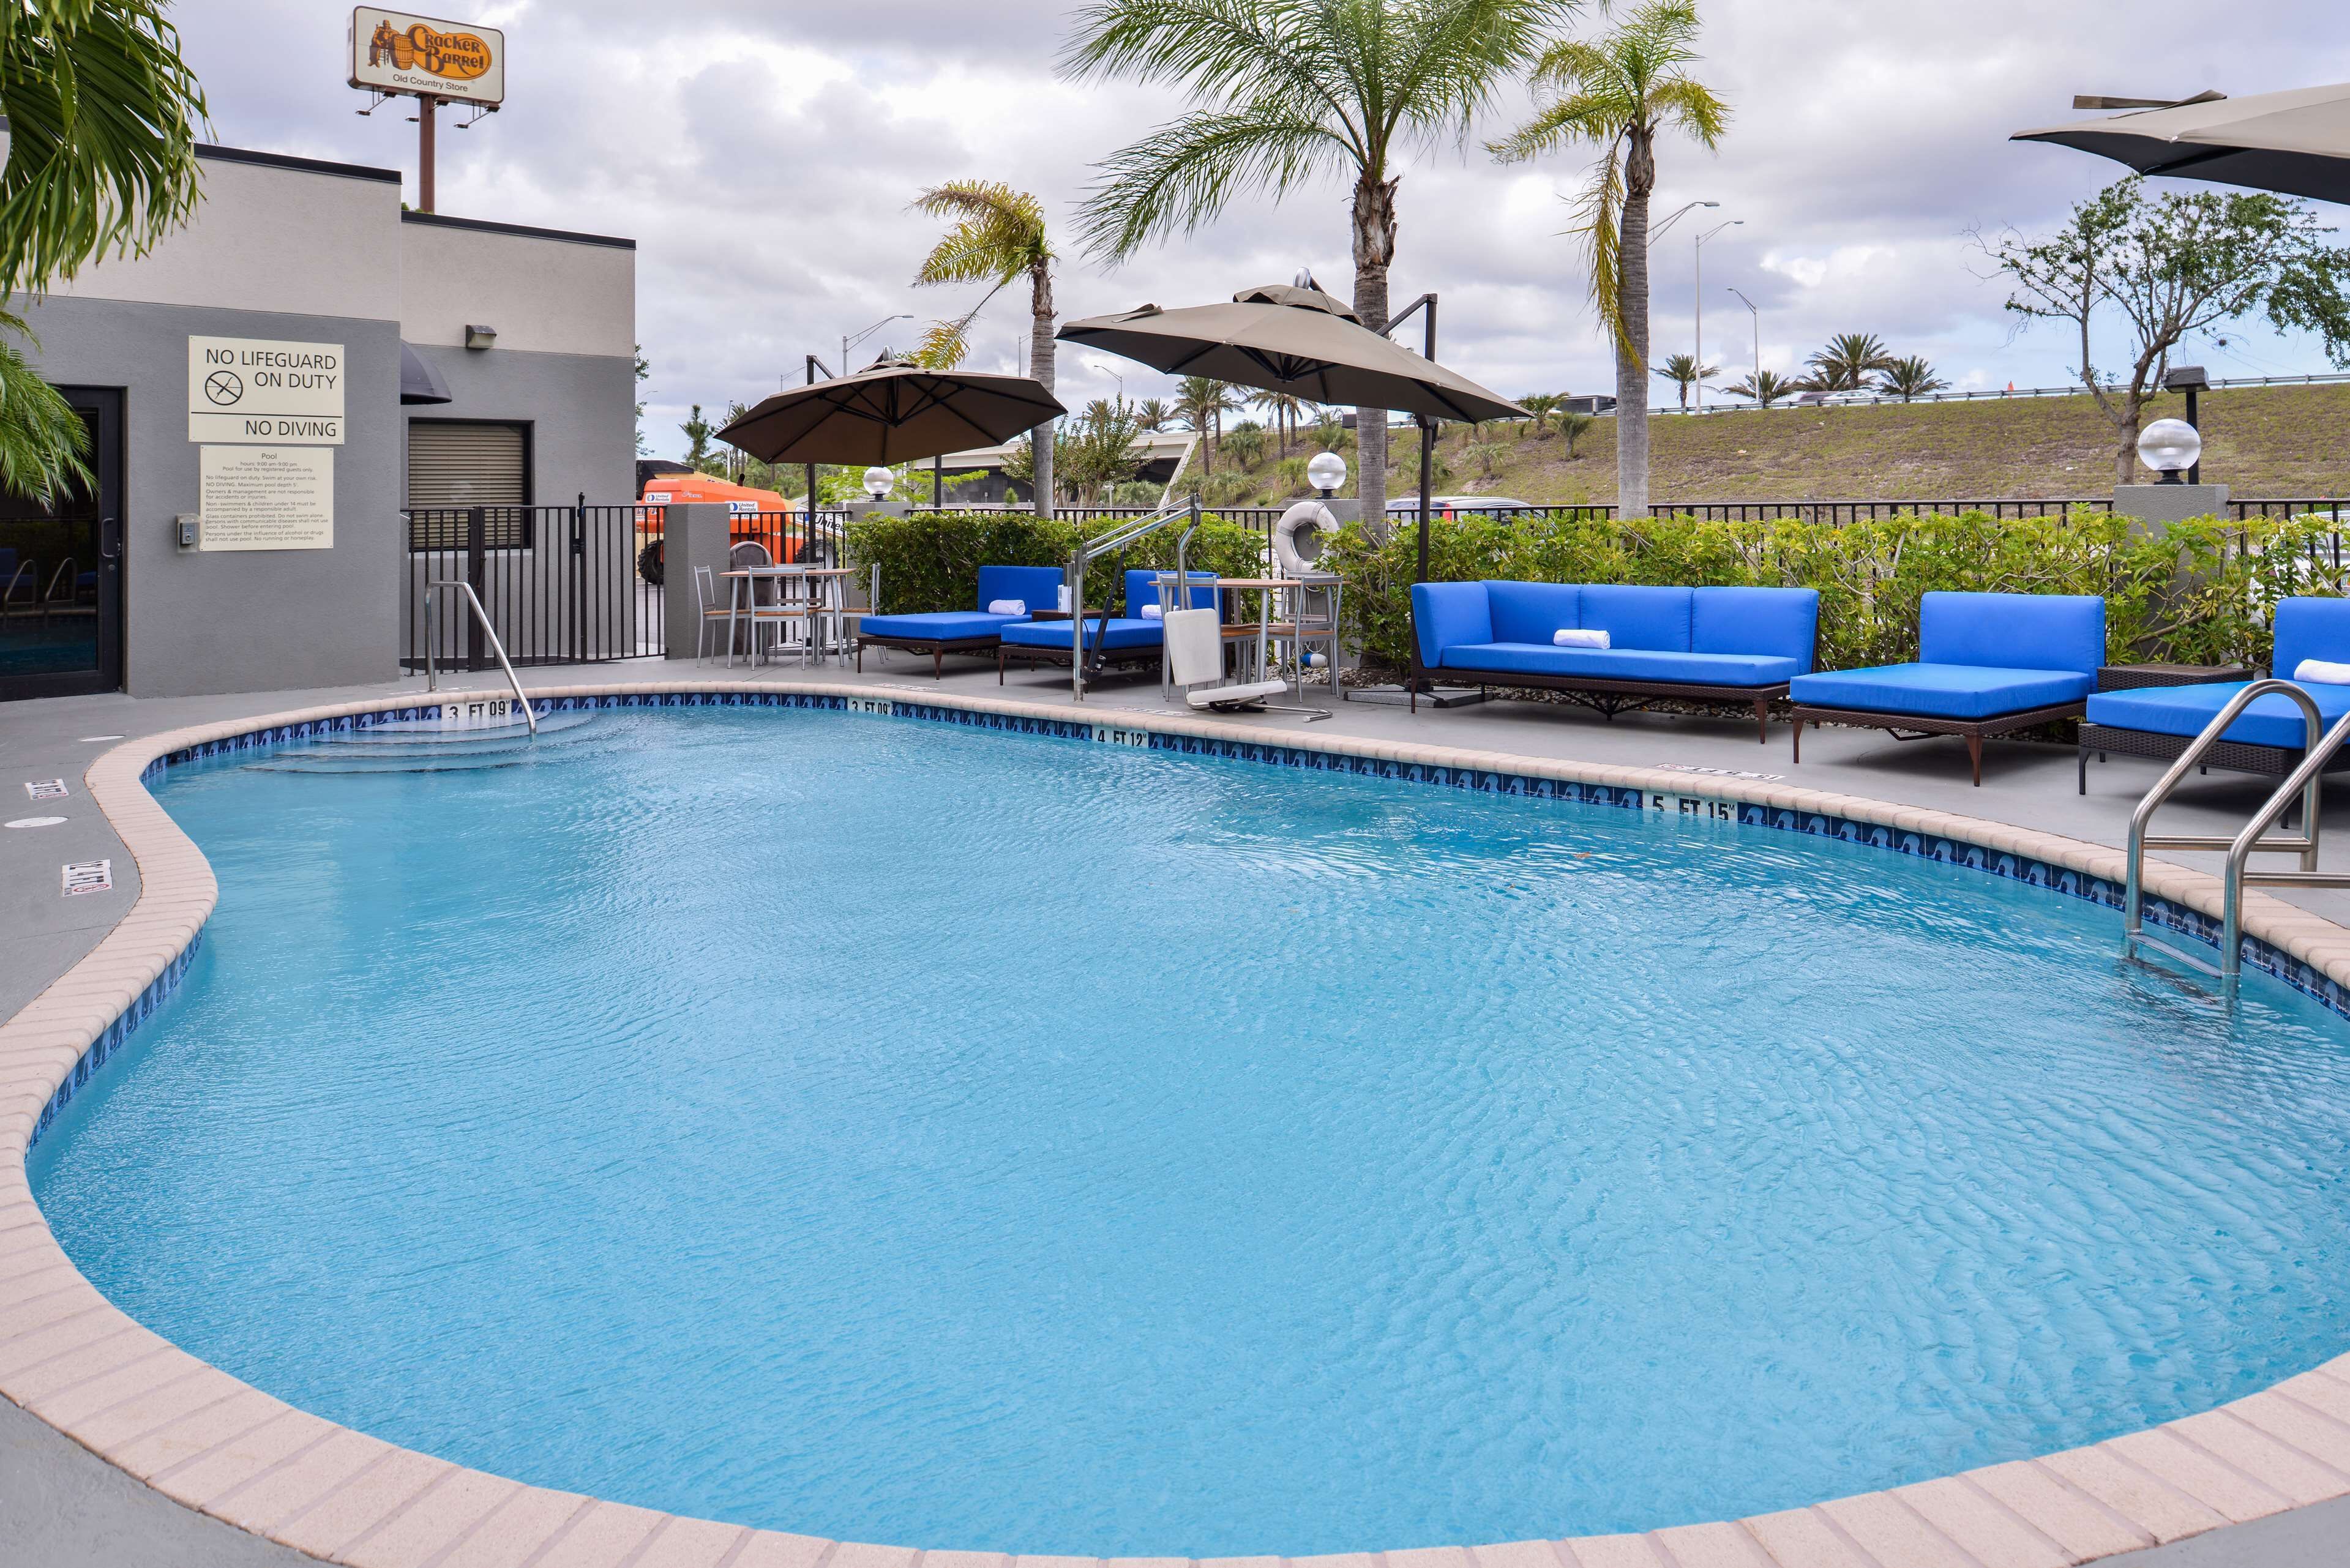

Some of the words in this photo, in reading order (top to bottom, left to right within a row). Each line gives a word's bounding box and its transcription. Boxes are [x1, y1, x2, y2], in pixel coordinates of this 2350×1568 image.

[393, 74, 408, 83] Old
[410, 77, 443, 89] Country
[446, 82, 468, 92] Store
[207, 349, 234, 364] NO
[242, 351, 336, 369] LIFEGUARD
[255, 372, 281, 387] ON
[290, 374, 336, 389] DUTY
[246, 420, 271, 435] NO
[279, 422, 335, 436] DIVING
[449, 706, 458, 718] 3
[470, 704, 484, 716] FT
[865, 702, 875, 712] FT
[1098, 730, 1105, 742] 4
[1113, 731, 1126, 744] FT
[1653, 796, 1664, 812] 5
[1680, 798, 1700, 816] FT
